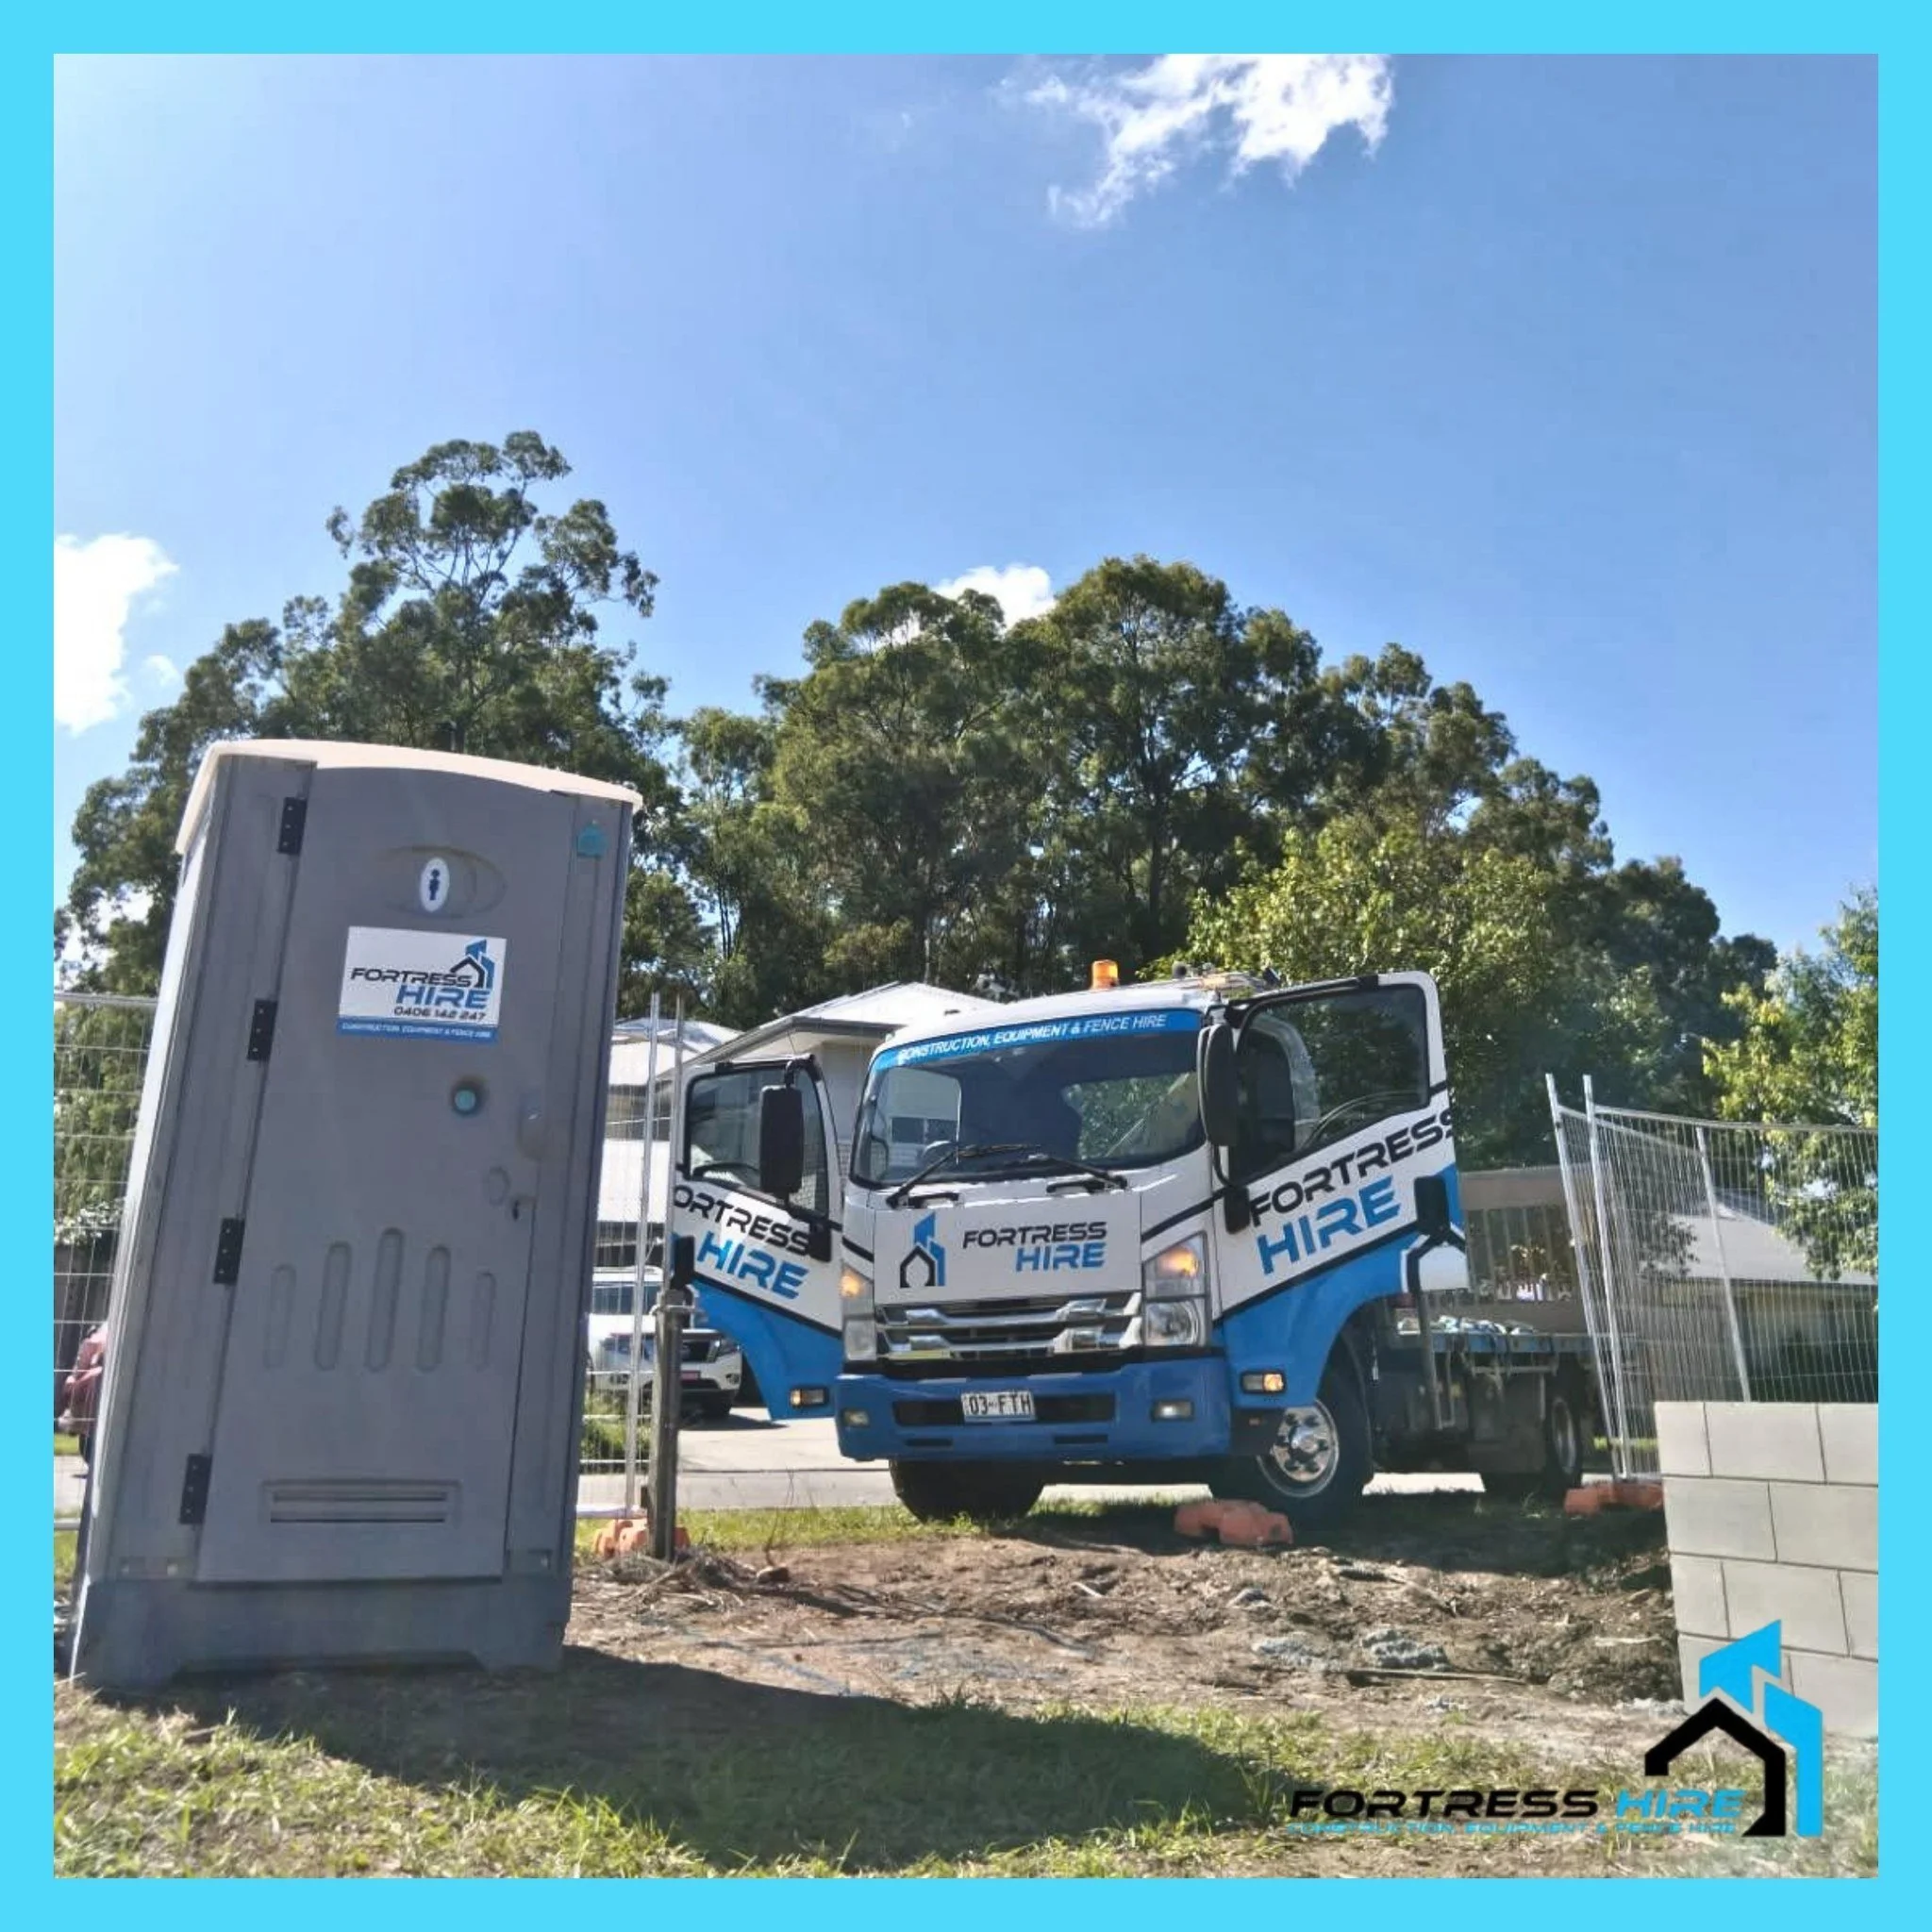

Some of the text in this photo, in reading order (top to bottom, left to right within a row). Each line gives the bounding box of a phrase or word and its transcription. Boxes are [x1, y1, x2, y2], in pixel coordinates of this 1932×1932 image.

[350, 968, 473, 988] FORTRESS
[396, 985, 491, 1009] HIRE
[993, 1021, 1068, 1044] EQUIPMENT
[1071, 1022, 1080, 1034] &
[1084, 1016, 1129, 1033] FENCE
[1132, 1014, 1168, 1028] HIRE
[673, 1185, 809, 1257] ORTRESS
[962, 1221, 1108, 1249] FORTRESS
[1257, 1174, 1401, 1274] HIRE
[696, 1230, 809, 1300] HIRE
[1015, 1241, 1107, 1272] HIRE
